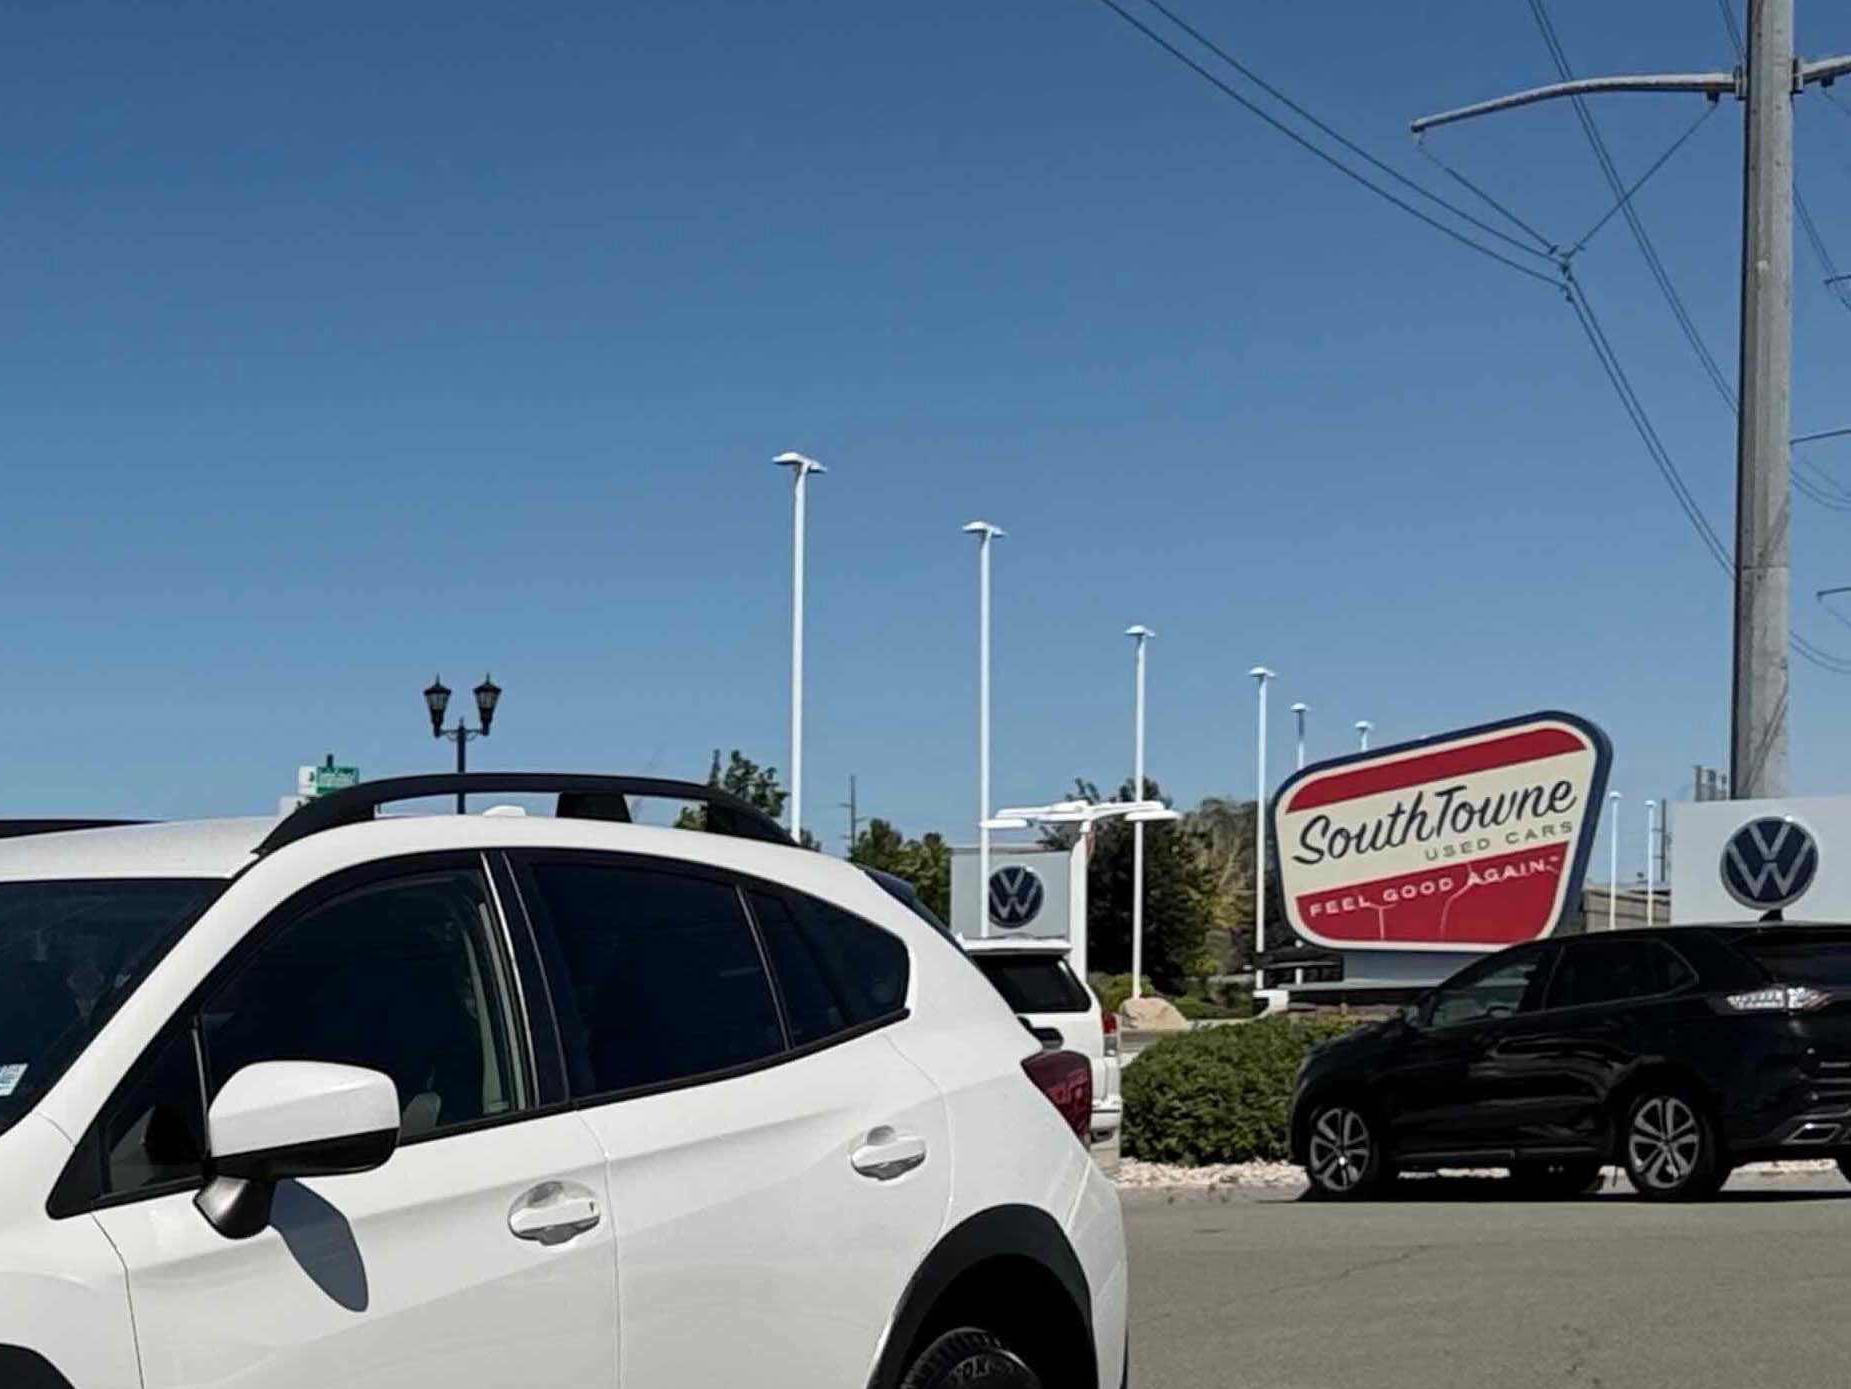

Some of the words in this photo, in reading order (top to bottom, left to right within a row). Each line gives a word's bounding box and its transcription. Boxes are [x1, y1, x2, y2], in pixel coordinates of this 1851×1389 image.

[1292, 779, 1578, 865] SouthTowne
[1425, 837, 1491, 862] USED
[1505, 820, 1573, 845] CARS
[1309, 894, 1372, 917] FEEL
[1383, 876, 1453, 903] GOOD
